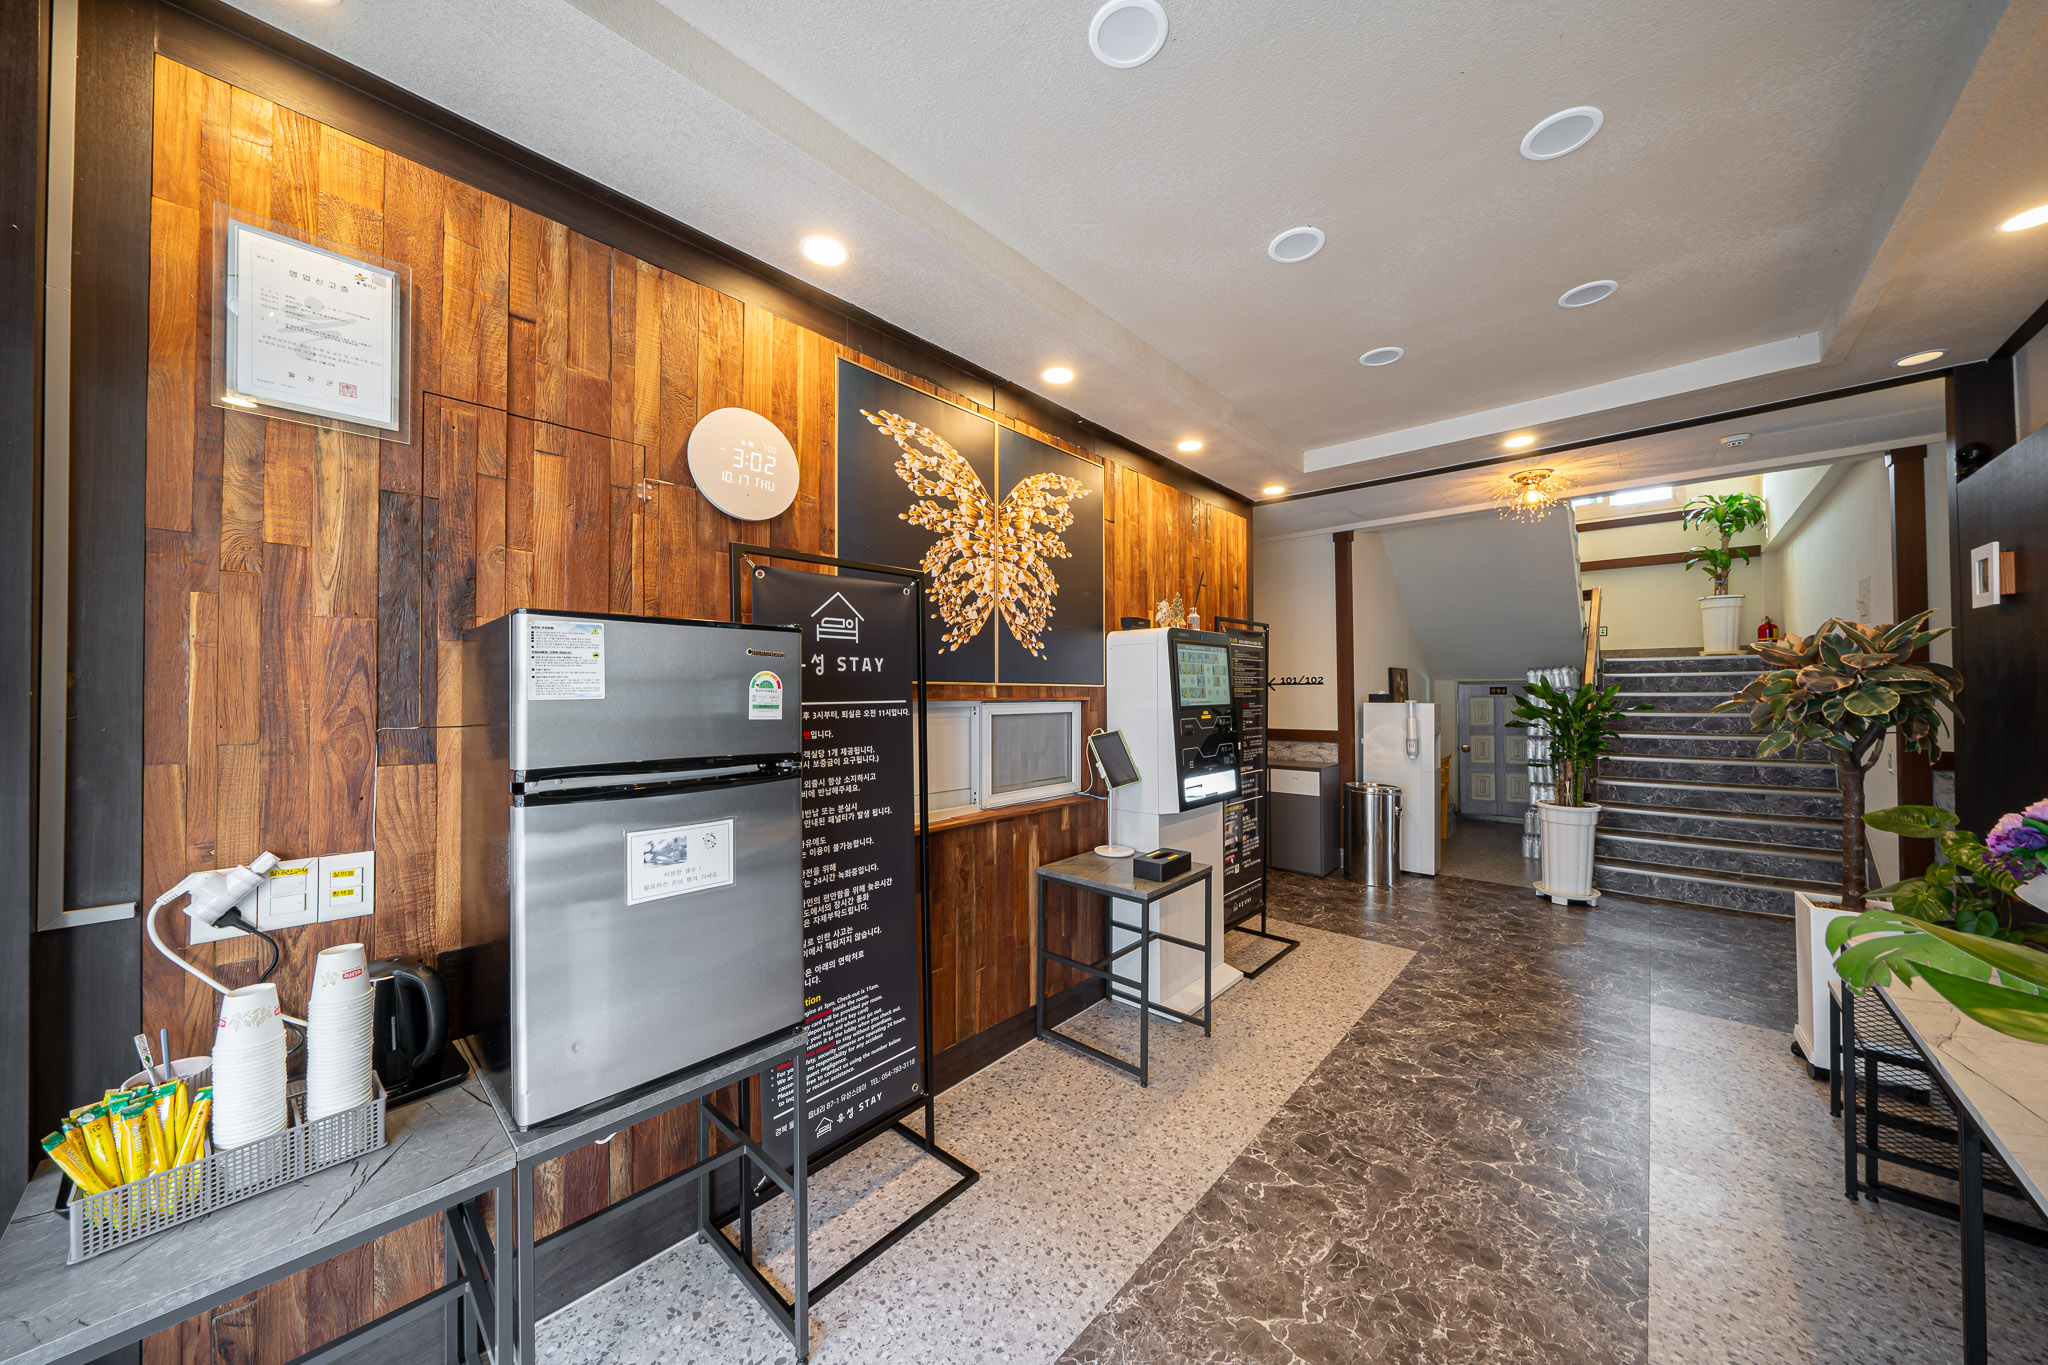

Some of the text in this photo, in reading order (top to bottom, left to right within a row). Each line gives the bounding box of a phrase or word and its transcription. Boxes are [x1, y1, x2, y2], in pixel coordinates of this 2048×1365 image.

[732, 447, 777, 476] 3:02
[754, 477, 776, 492] THU
[836, 656, 884, 673] STAY
[1280, 675, 1324, 685] 101/102
[802, 708, 911, 720] 후 3시부터, 퇴실은 오전 11시입니다.
[802, 730, 834, 740] 연입니다.
[803, 745, 875, 760] 객실당 1개 제공됩니다.
[800, 754, 880, 769] 시 보증금이 요구됩니다.)
[804, 772, 877, 788] 외출시 항상 소지하시고
[801, 784, 861, 799] 비에 반납해주세요.
[801, 802, 858, 819] 반납 또는 분실시
[803, 806, 893, 829] 안내된 패널티가 발생 됩니다.
[809, 845, 831, 856] 이용이
[832, 836, 875, 852] 불가능합니다.
[663, 866, 697, 878] 시원한 생수
[822, 863, 837, 873] 위해
[803, 863, 879, 889] 는 24시간 녹화중입니다.
[643, 881, 669, 891] 필요하신
[823, 888, 851, 903] 편안함을
[852, 884, 866, 895] 위해
[868, 877, 893, 891] 늦은시간
[803, 892, 870, 918] 도에서의 장시간 통화
[803, 902, 869, 928] 은 자제부탁드립니다.
[816, 932, 831, 944] 인한
[833, 926, 854, 938] 사고는
[825, 935, 853, 950] 책임지지
[854, 926, 883, 942] 않습니다.
[804, 950, 865, 978] 은 아래의 연락처로
[804, 975, 821, 987] 니다.
[804, 995, 822, 1007] tion
[776, 1060, 794, 1072] Minor
[776, 1071, 787, 1079] For
[786, 1067, 794, 1076] yo
[777, 1082, 794, 1093] cause
[826, 1097, 840, 1110] 87-1
[836, 1091, 883, 1124] 유성 STAY
